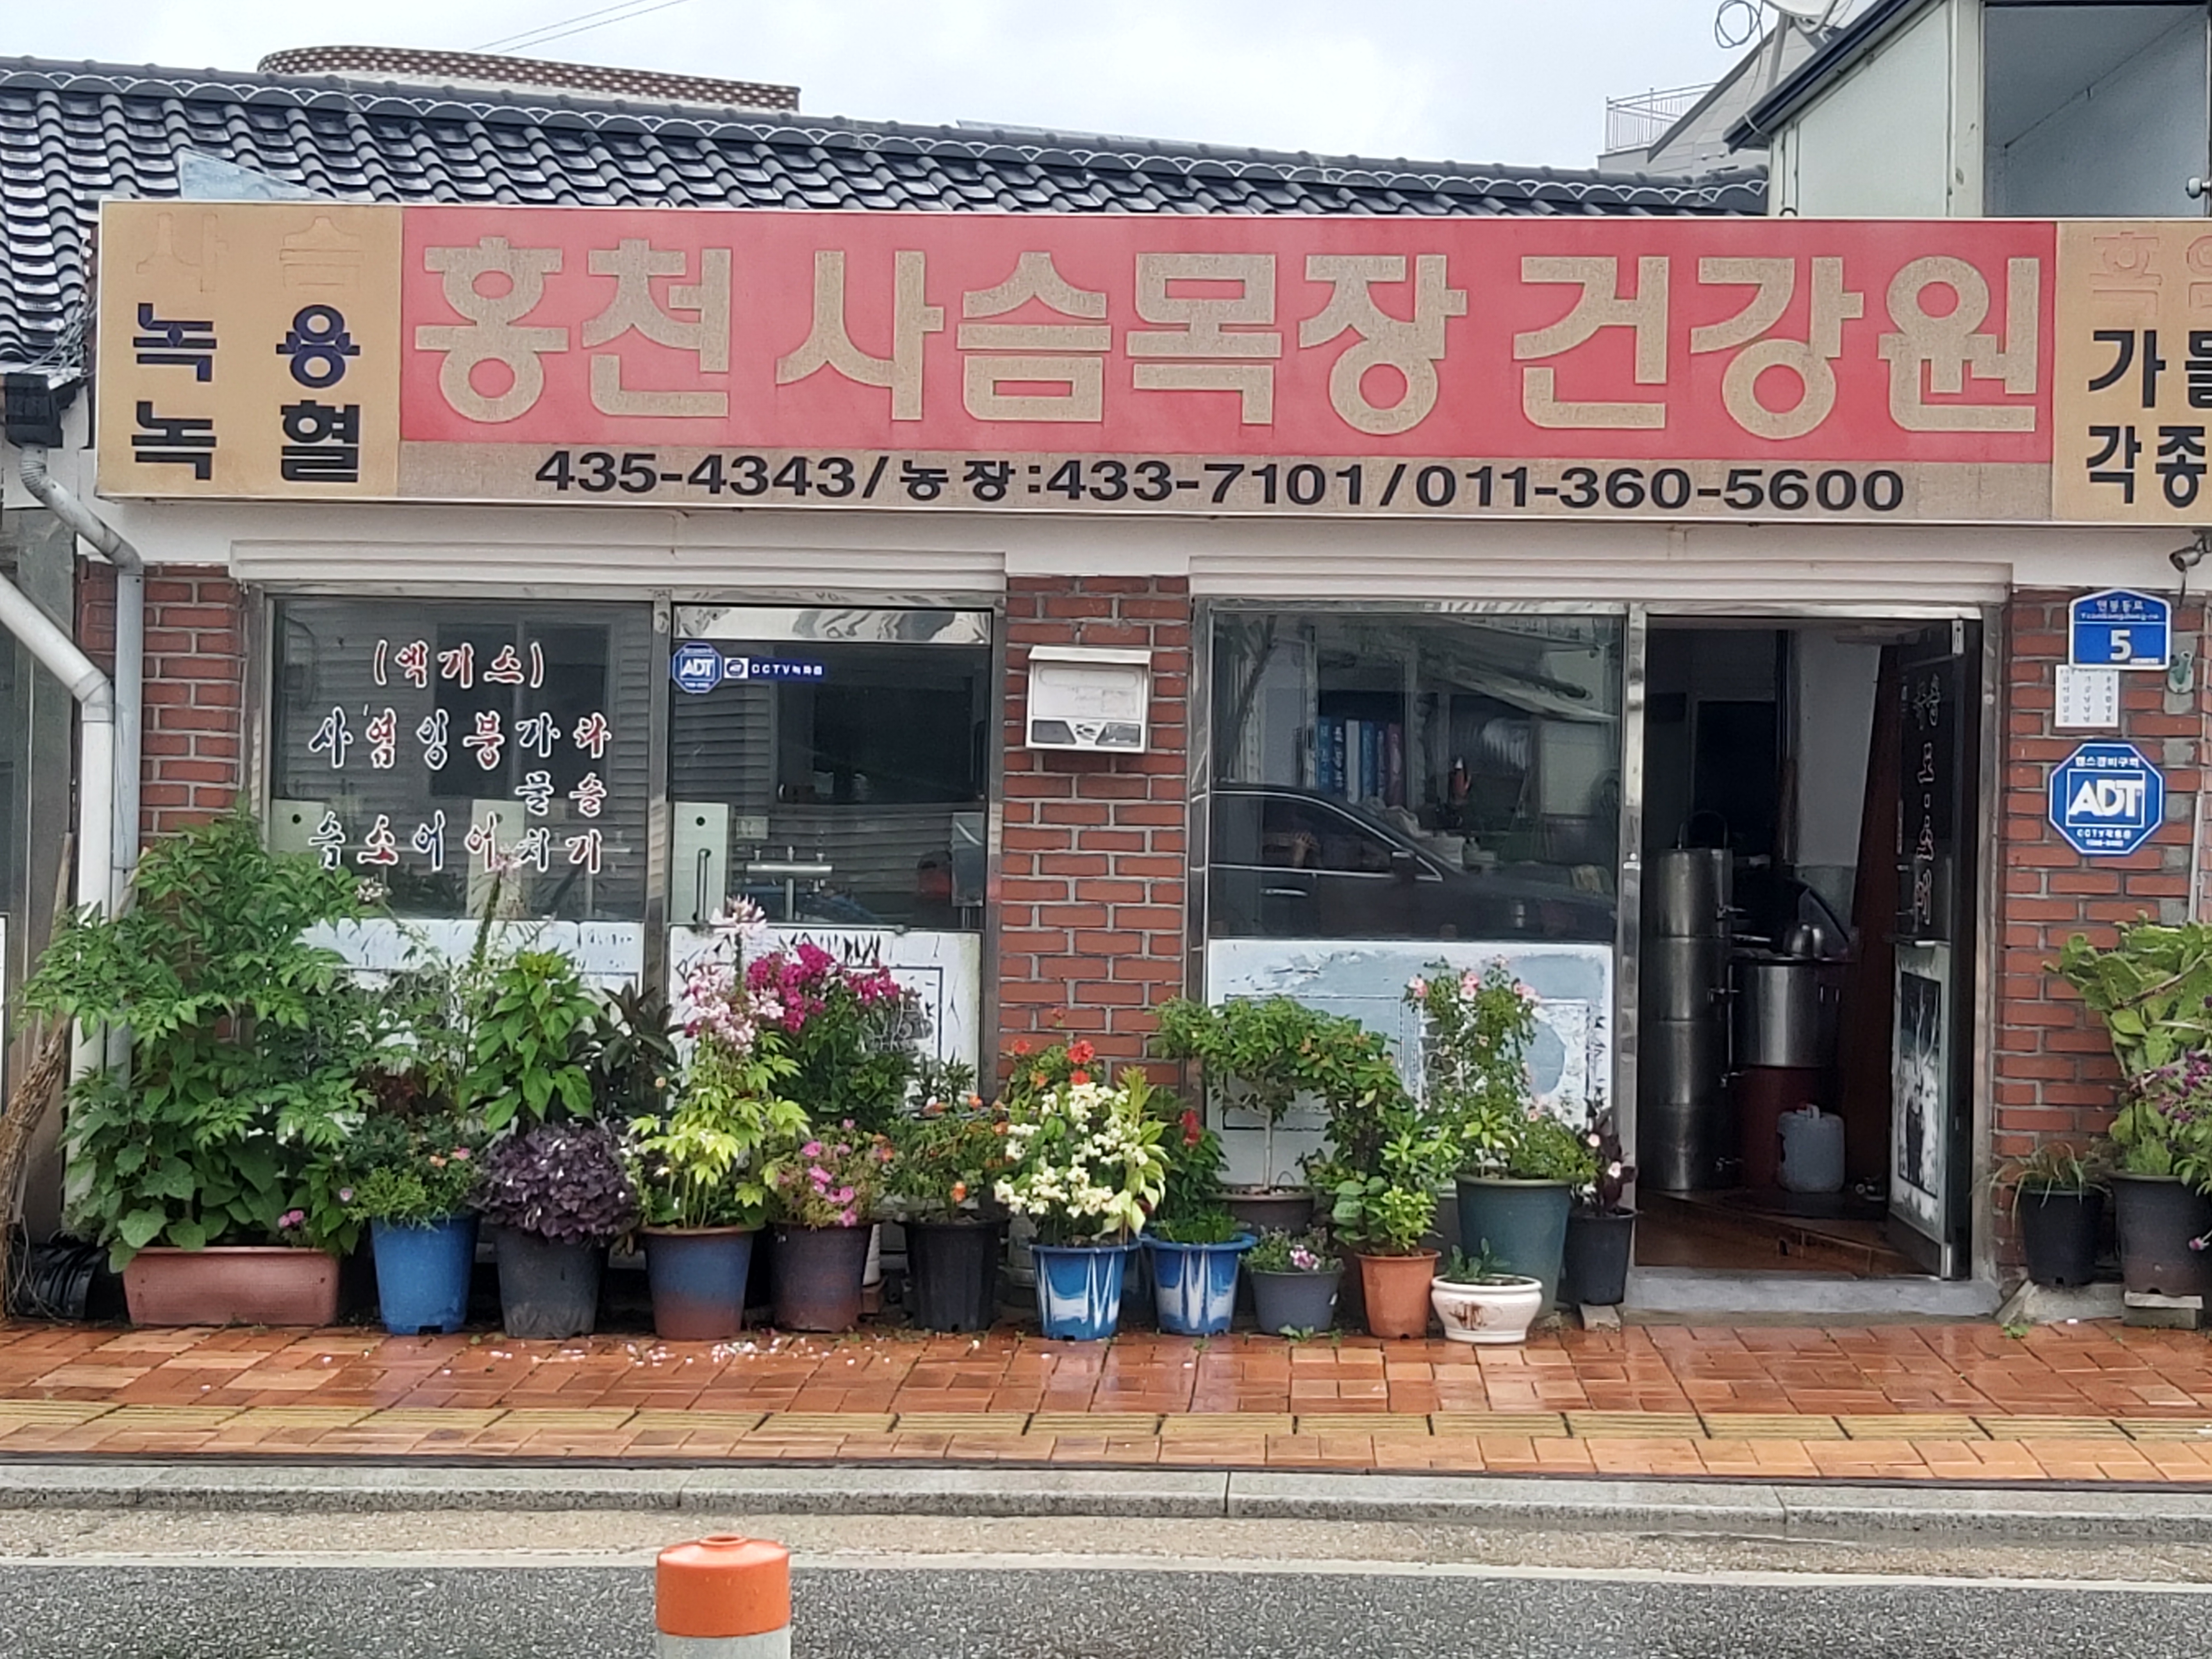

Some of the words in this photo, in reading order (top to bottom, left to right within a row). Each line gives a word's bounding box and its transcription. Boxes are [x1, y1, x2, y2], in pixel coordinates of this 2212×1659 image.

[132, 302, 361, 388] 녹용
[415, 236, 732, 423] 홍천
[775, 251, 1468, 436] 사슴목장
[1512, 256, 2040, 439] 건강원
[130, 399, 360, 483] 녹혈
[2086, 426, 2207, 508] 각종
[681, 658, 714, 678] ADT
[2110, 630, 2132, 661] 5
[2068, 779, 2144, 817] ADT
